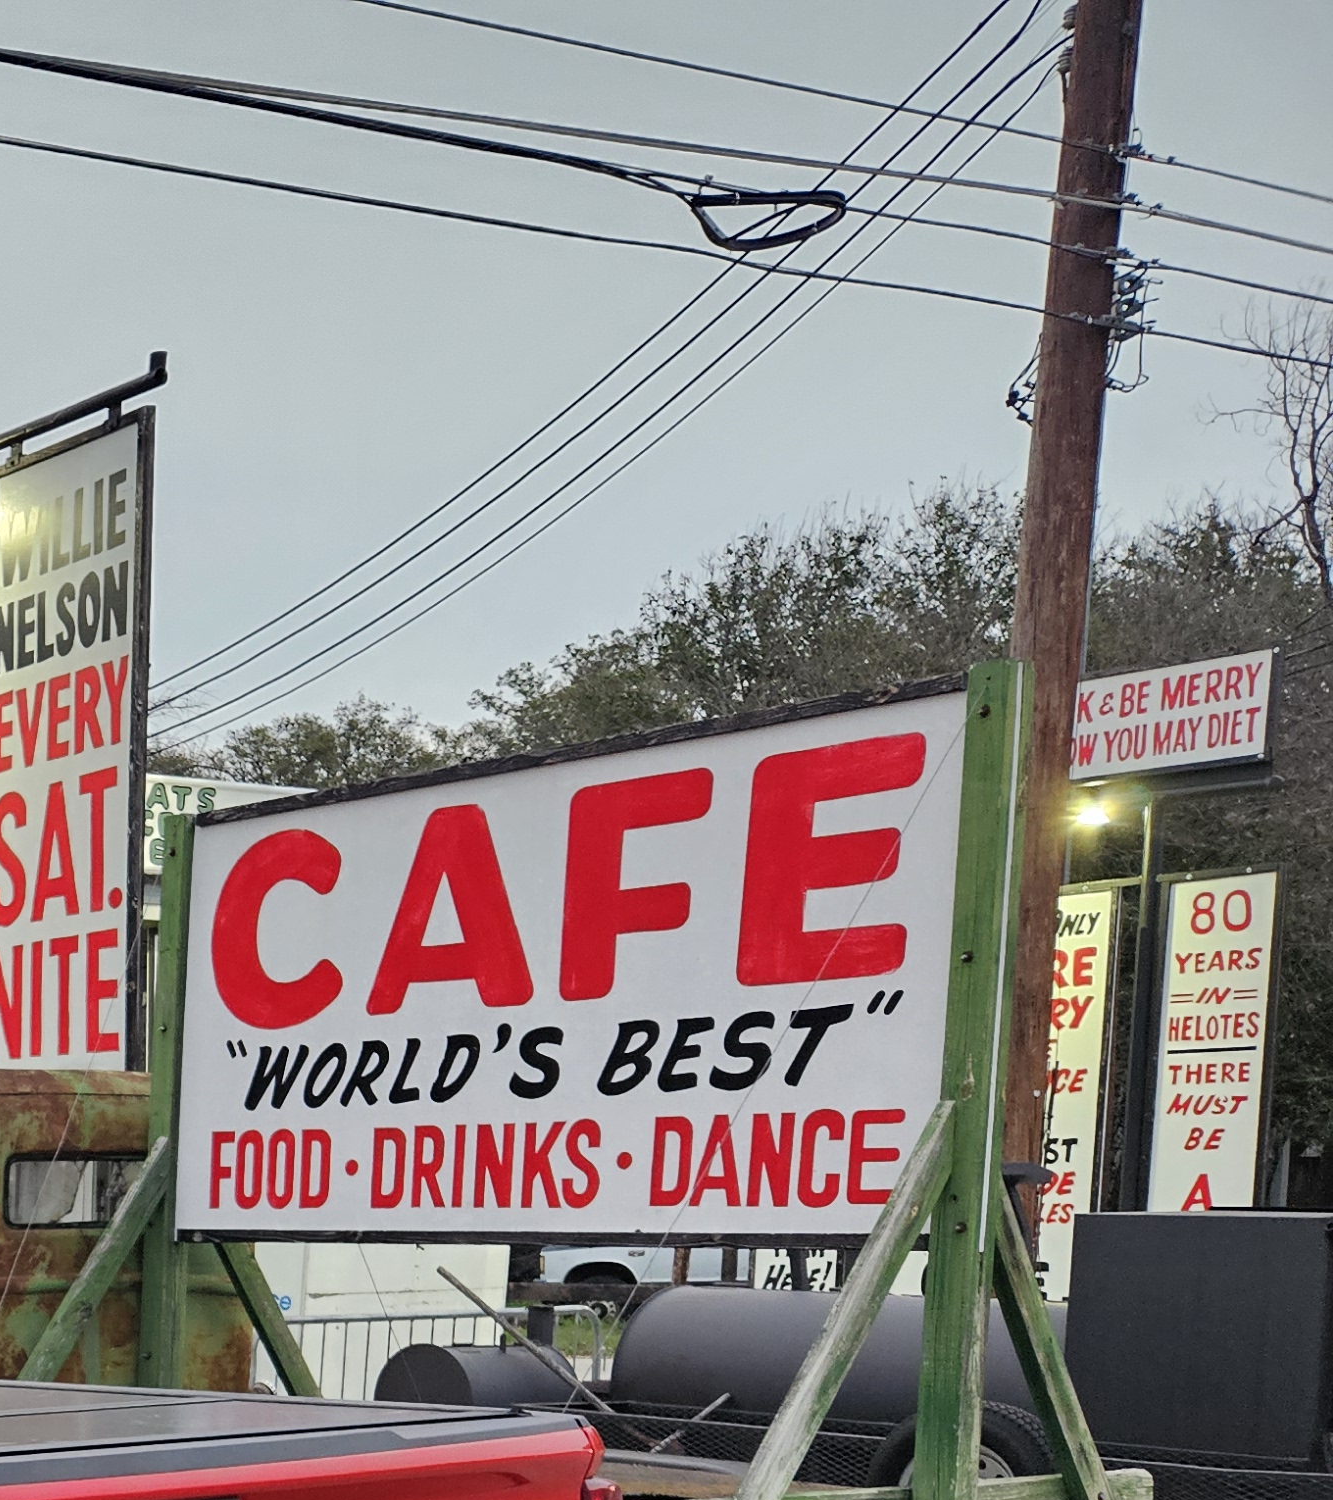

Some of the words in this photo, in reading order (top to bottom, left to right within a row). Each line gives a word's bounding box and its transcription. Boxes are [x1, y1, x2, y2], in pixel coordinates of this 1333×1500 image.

[1098, 692, 1115, 716] &
[1119, 681, 1152, 718] BE
[1160, 661, 1264, 713] MERRY
[1104, 722, 1147, 763] YOU
[1152, 715, 1203, 756] MAY
[1207, 706, 1262, 749] DIET
[211, 731, 928, 1031] CAFE
[1190, 889, 1253, 935] 80
[1175, 947, 1263, 974] YEARS
[1195, 986, 1232, 1005] IN
[1167, 1011, 1261, 1042] HELOTES
[1168, 1061, 1251, 1085] THERE
[1167, 1094, 1249, 1116] MUST
[1184, 1127, 1225, 1150] BE
[208, 1127, 332, 1210] FOOD
[369, 1117, 602, 1211] DRINKS
[649, 1108, 908, 1208] DANCE
[1180, 1173, 1213, 1212] A
